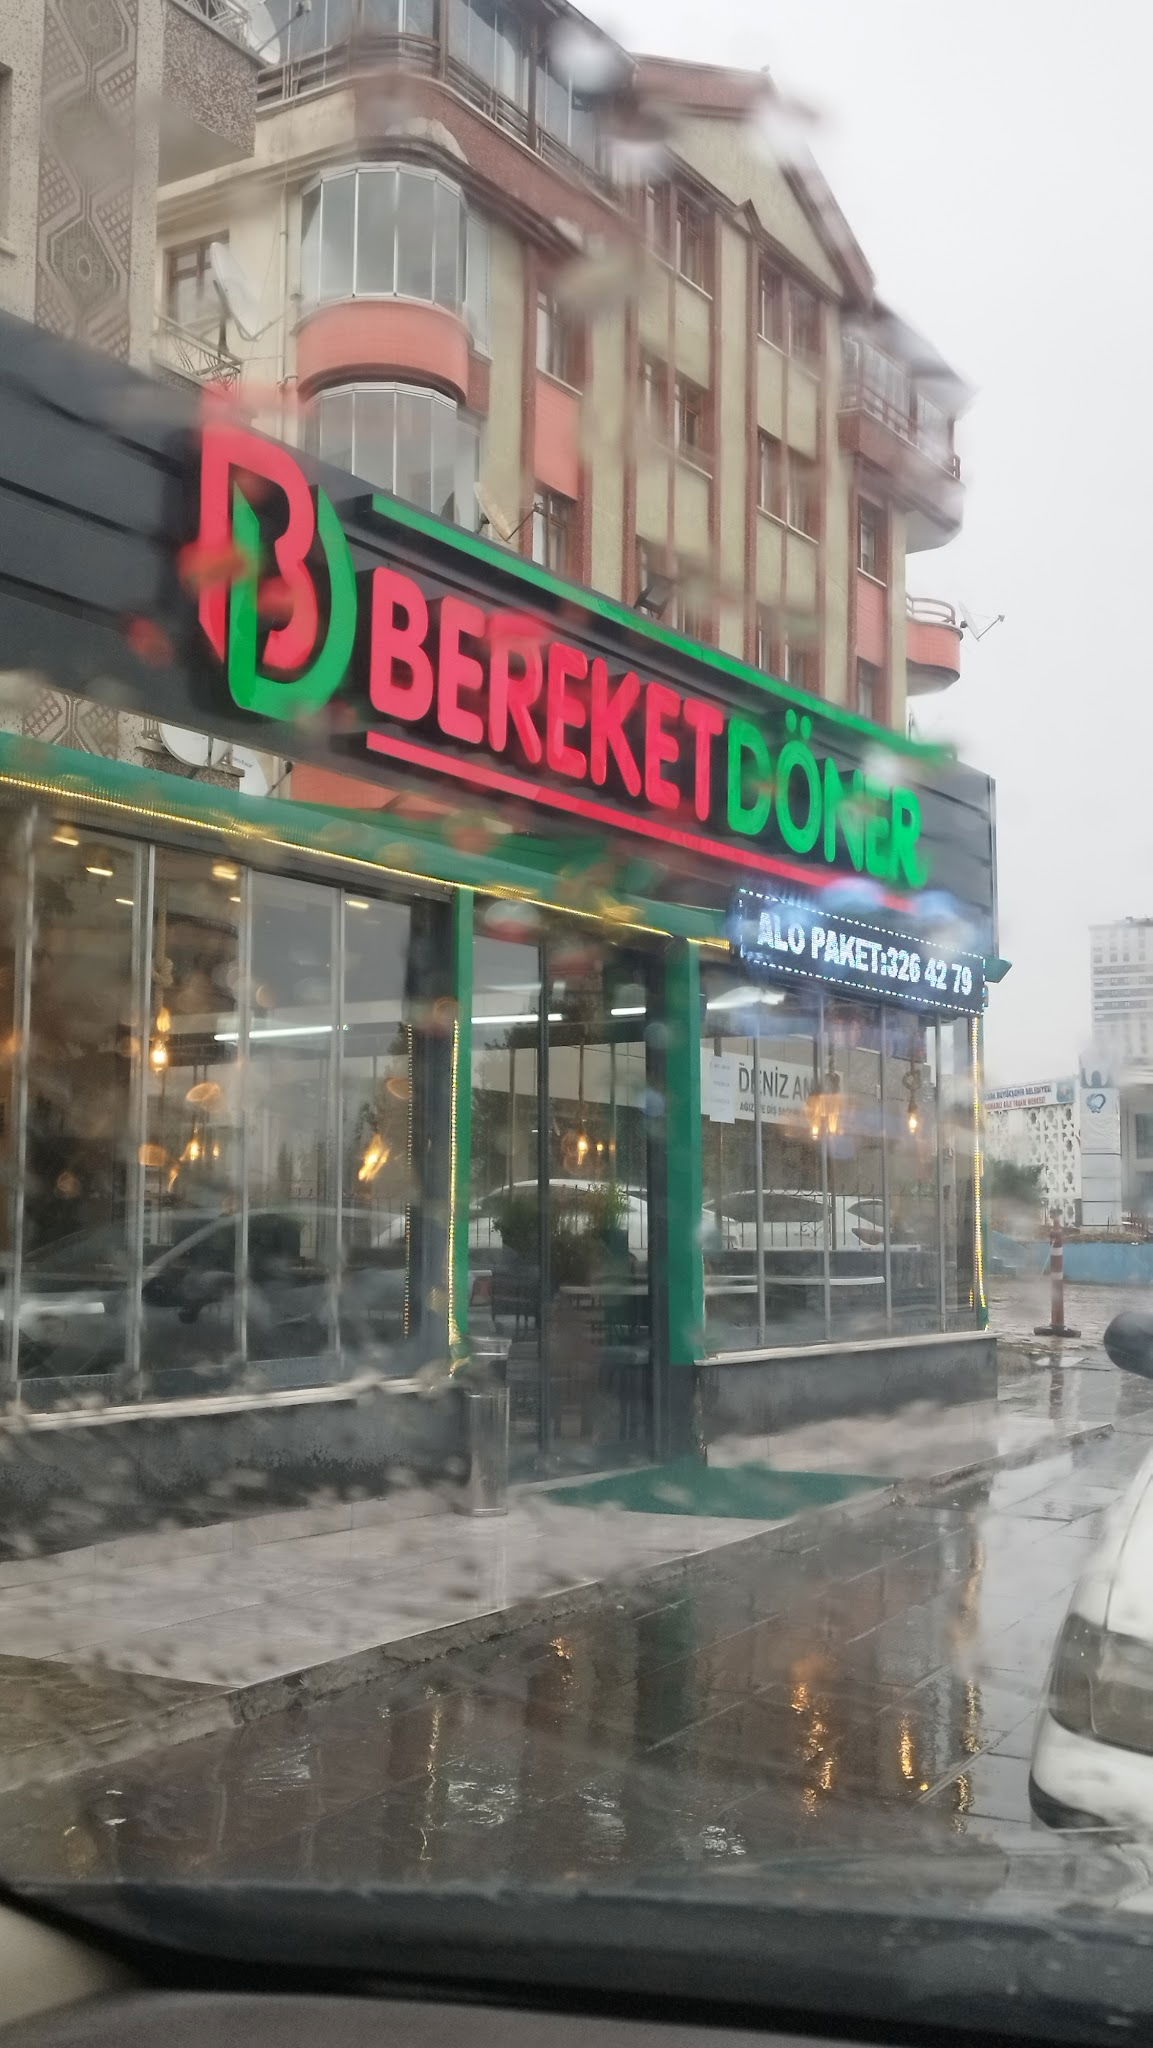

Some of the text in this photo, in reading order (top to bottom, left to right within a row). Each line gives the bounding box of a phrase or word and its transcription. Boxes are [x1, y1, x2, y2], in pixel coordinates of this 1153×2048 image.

[369, 567, 928, 890] BEREKET DÖNER
[757, 912, 973, 996] ALO PAKET:326 42 79
